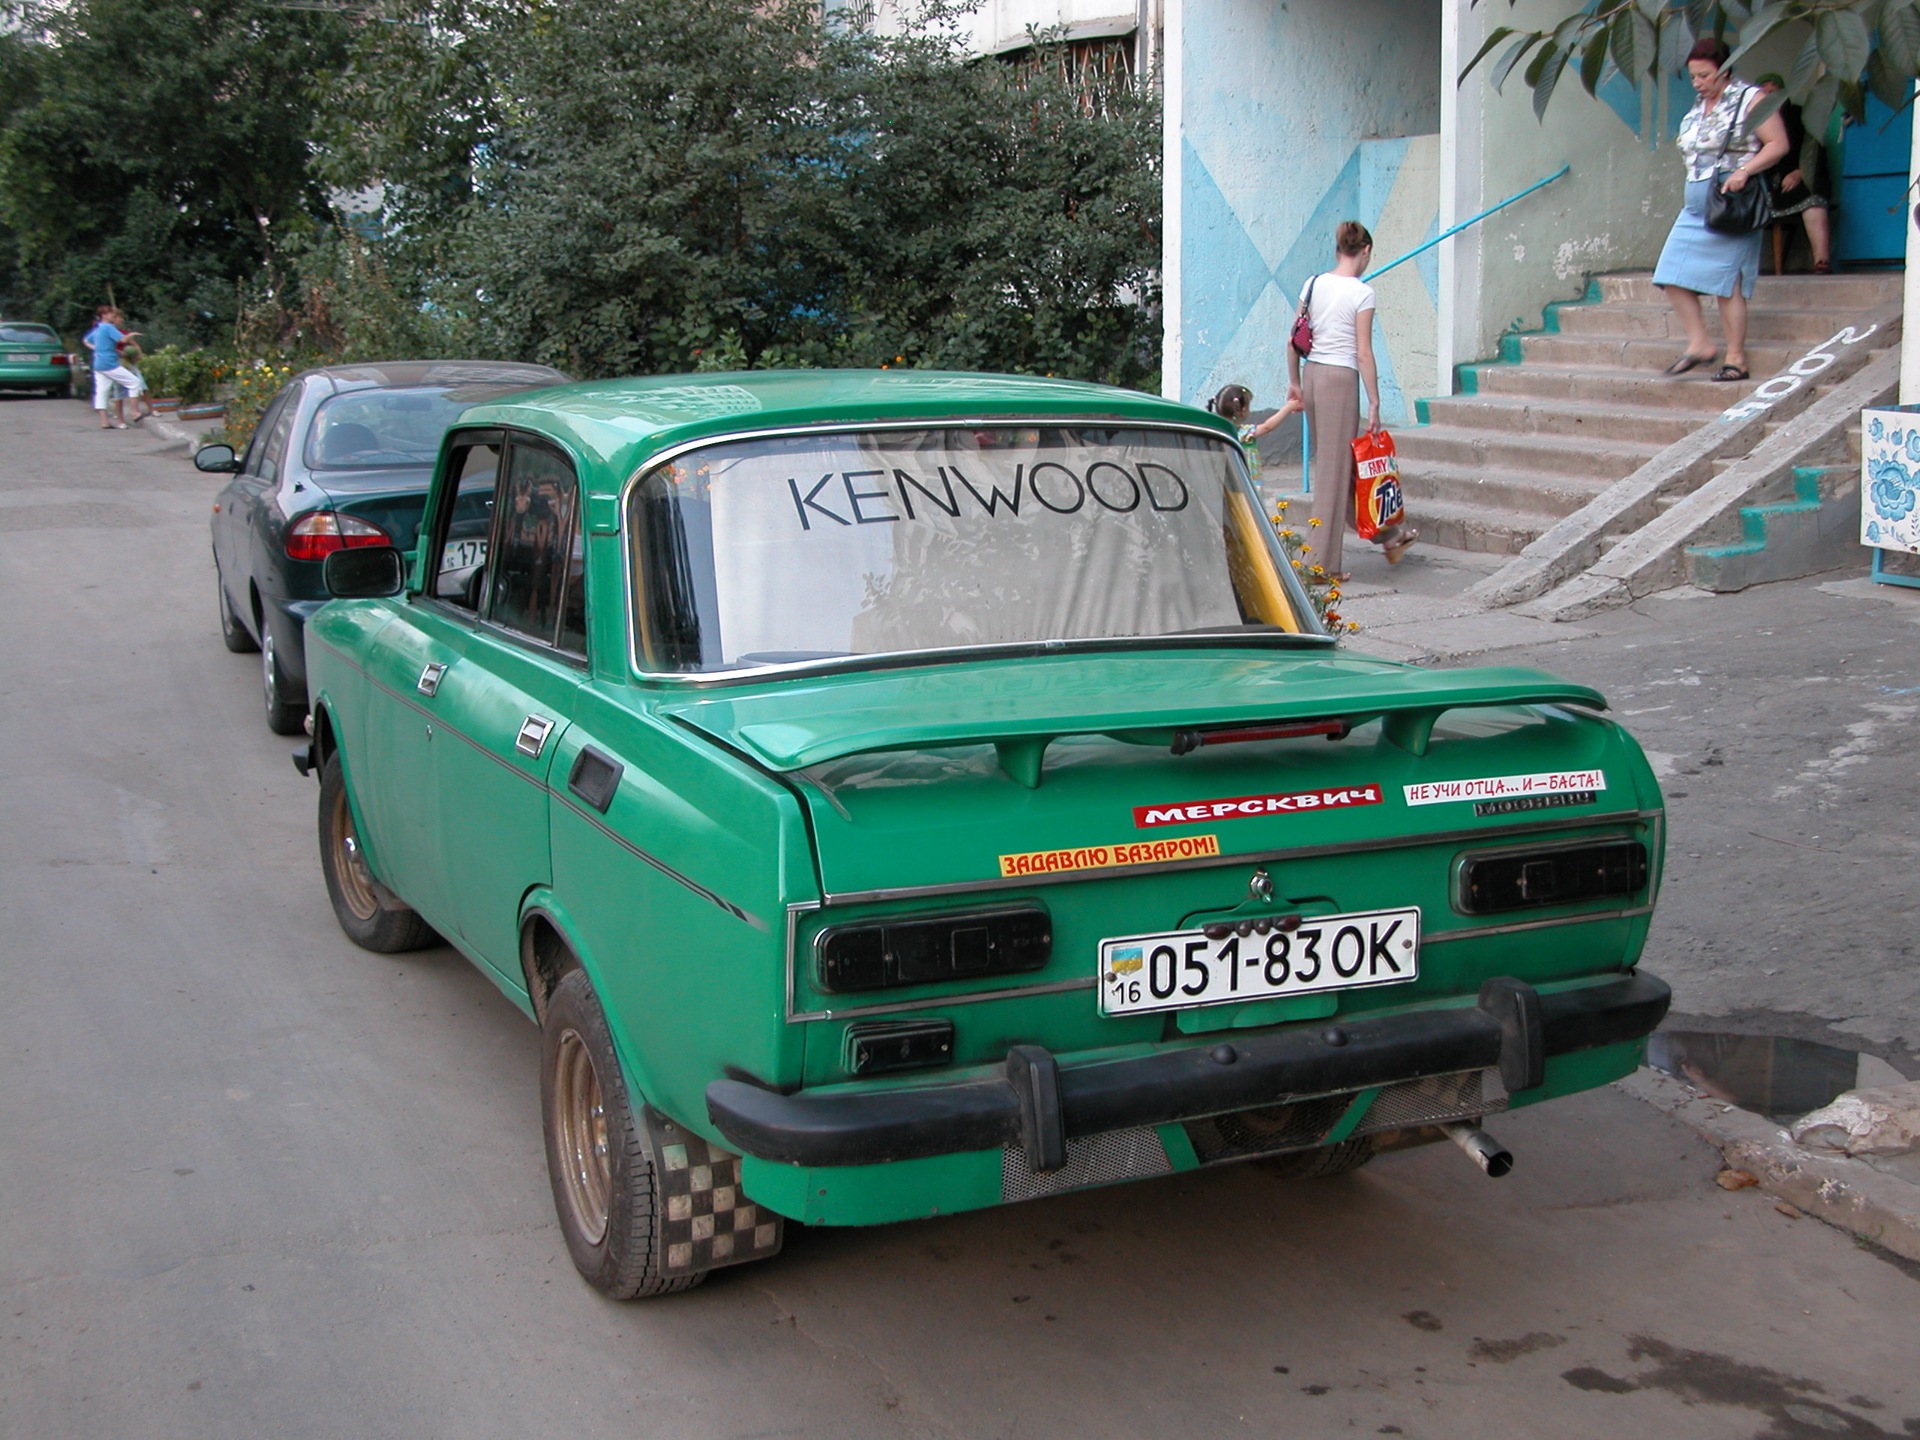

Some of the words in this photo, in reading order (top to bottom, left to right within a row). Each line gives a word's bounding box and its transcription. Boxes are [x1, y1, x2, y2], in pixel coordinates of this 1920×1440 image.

[788, 462, 1189, 530] KENWOOD
[1375, 480, 1403, 528] Tide
[1145, 788, 1376, 824] МЕРСКВИЧ
[1410, 786, 1430, 801] НЕ
[1434, 783, 1461, 799] УЧИ
[1004, 846, 1108, 875] ЗАДАВЛЮ
[1114, 834, 1217, 864] БАЗАРОМ!
[1112, 981, 1141, 1004] 16
